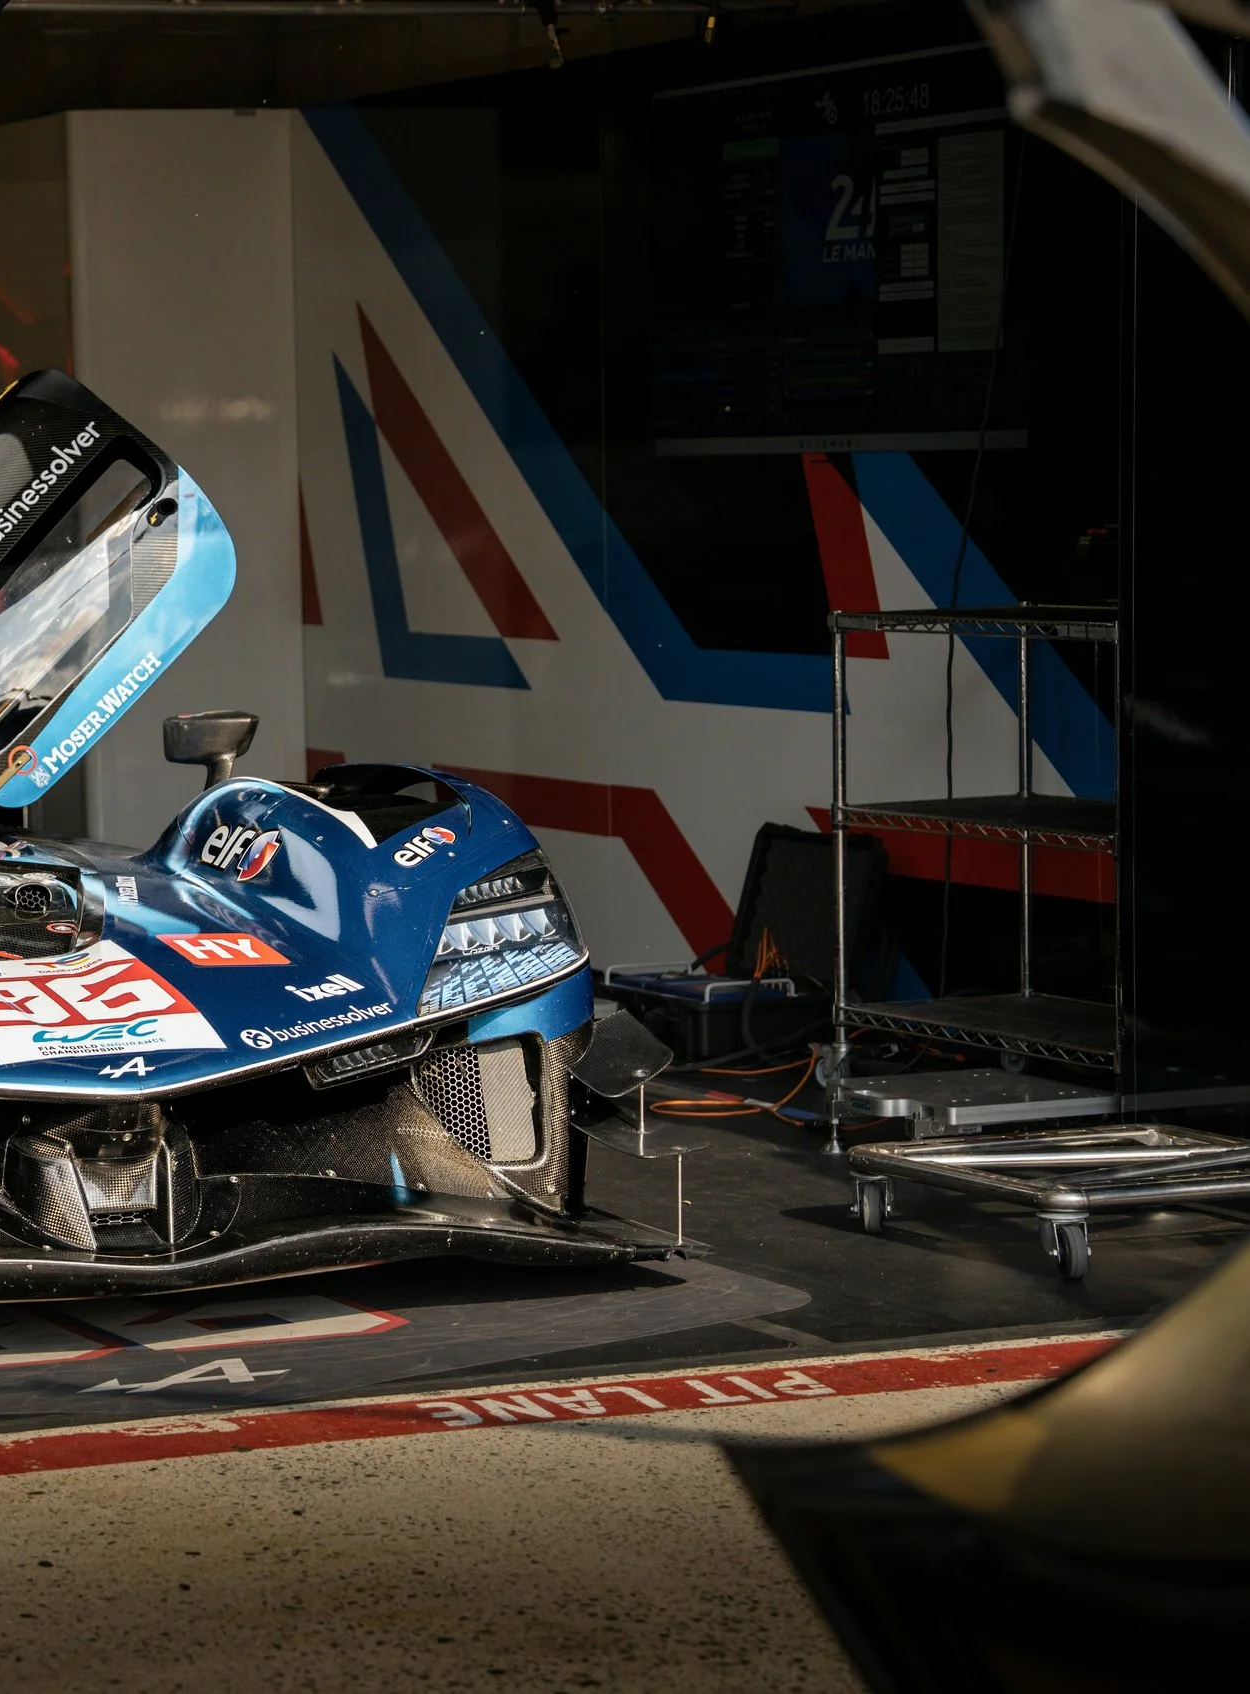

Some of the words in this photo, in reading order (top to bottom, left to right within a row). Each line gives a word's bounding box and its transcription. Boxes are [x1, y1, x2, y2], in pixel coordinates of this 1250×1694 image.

[863, 83, 930, 116] 18:25:48
[822, 245, 841, 264] LE
[41, 651, 163, 775] MOSER.WATCH
[201, 824, 256, 871] elf
[393, 835, 437, 867] elf
[169, 938, 263, 960] HY
[284, 972, 366, 1002] ixell
[32, 1018, 159, 1043] WEC
[273, 1001, 394, 1042] businessolver
[41, 1046, 125, 1056] CHAMPIONSHIP
[58, 1043, 98, 1051] WORLD
[100, 1037, 167, 1048] ENDURANCE
[684, 1370, 838, 1405] PIT
[417, 1386, 668, 1428] LANE
